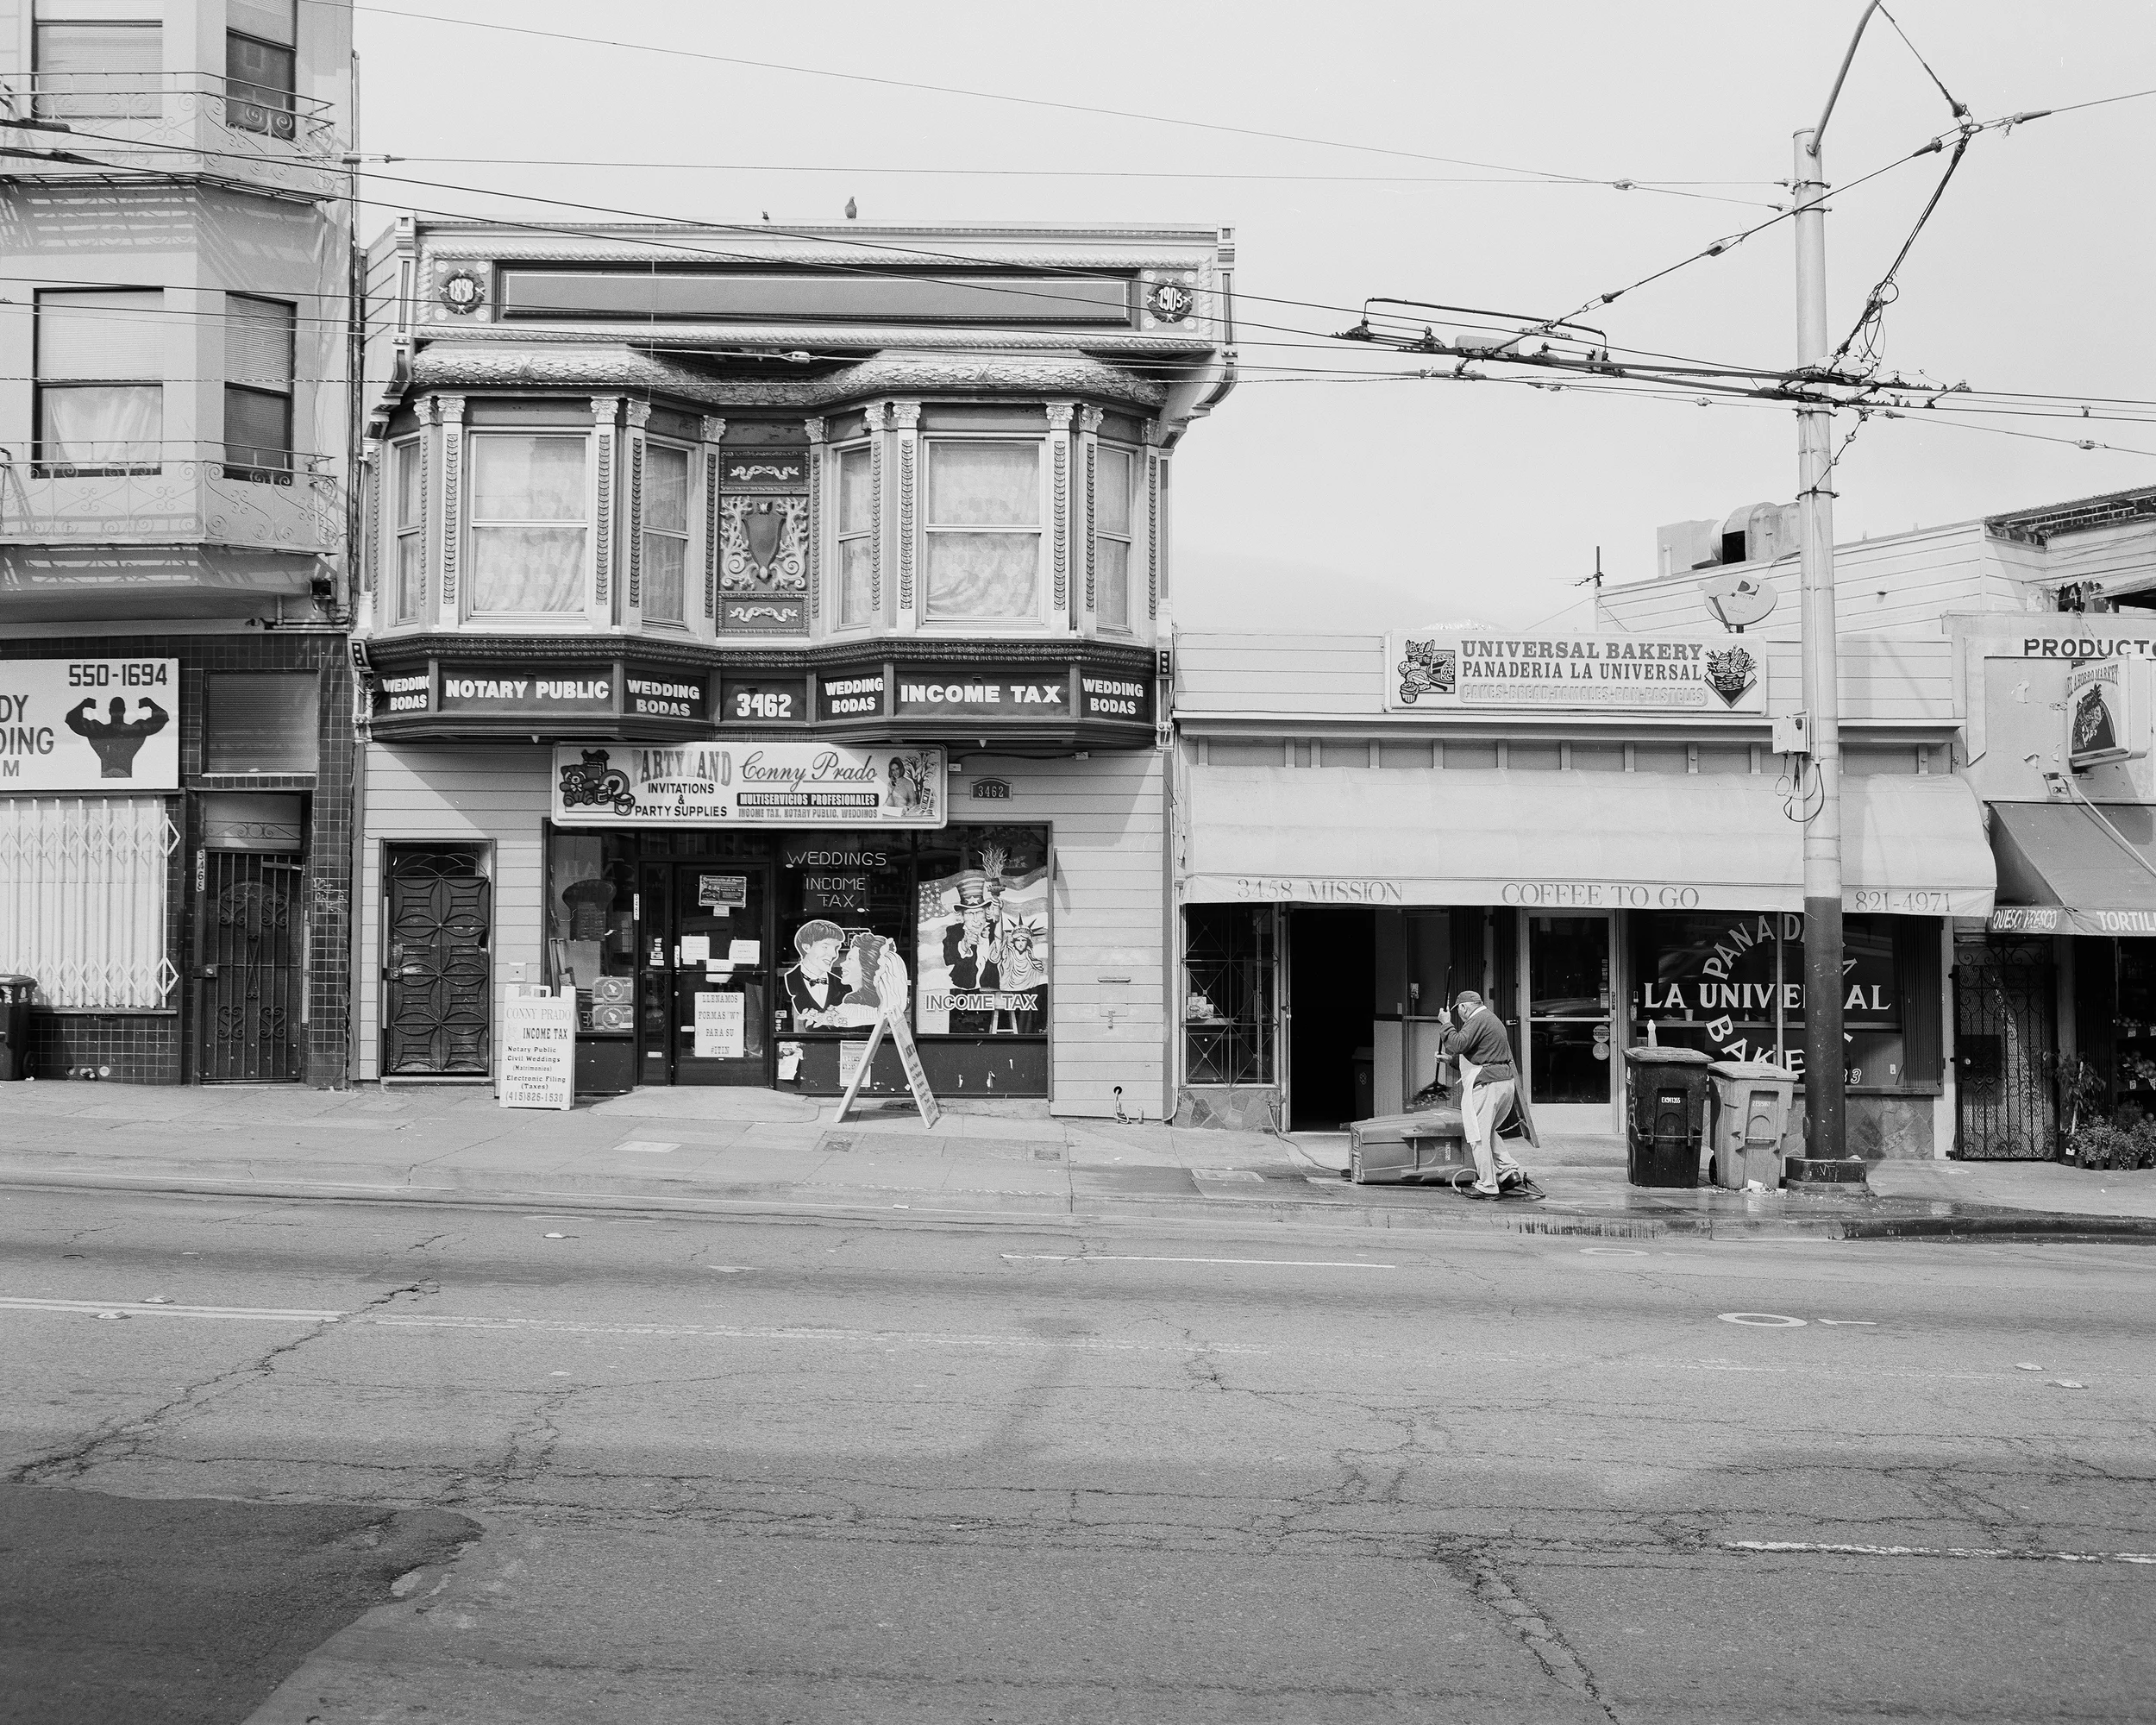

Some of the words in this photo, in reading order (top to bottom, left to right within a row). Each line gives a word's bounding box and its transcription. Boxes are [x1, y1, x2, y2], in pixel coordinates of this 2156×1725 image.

[1158, 286, 1183, 311] 1905
[1461, 641, 1600, 660] UNIVERSAL
[1606, 642, 1703, 661] BAKERY
[2024, 639, 2156, 657] PRODUCT
[69, 663, 167, 687] 550-1694
[1463, 662, 1564, 680] PANADERIA
[1570, 662, 1594, 680] LA
[1600, 662, 1702, 681] UNIVERSAL
[2095, 664, 2118, 686] MARKET
[446, 681, 529, 699] NOTARY
[536, 681, 609, 699] PUBLIC
[626, 680, 700, 700] WEDDING
[824, 677, 884, 696] WEDDING
[900, 685, 1000, 703] INCOME
[1010, 685, 1062, 703] TAX
[1082, 678, 1144, 698] WEDDING
[390, 694, 428, 712] BODAS
[636, 699, 691, 717] BODAS
[736, 693, 792, 718] 3462
[832, 697, 876, 713] BODAS
[1090, 698, 1136, 715] BODAS
[739, 750, 807, 793] Conny
[812, 751, 878, 781] Prado
[648, 783, 715, 794] INVITATIONS
[978, 785, 1004, 798] 3462
[677, 794, 685, 805] &
[739, 794, 808, 806] MULTISERVICIOS
[811, 794, 875, 806] PROFESIONALES
[635, 806, 672, 817] PARTY
[674, 806, 728, 817] SUPPLIES
[738, 808, 764, 818] INCOME
[784, 808, 811, 819] NOTARY
[841, 808, 878, 819] WEDDINGS
[787, 851, 887, 866] WEDDINGS
[805, 877, 866, 891] INCOME
[1237, 878, 1293, 900] 3458
[1307, 880, 1403, 902] MISSION
[817, 894, 855, 908] TAX
[1501, 882, 1602, 906] COFFEE
[1611, 886, 1650, 907] TO
[1658, 887, 1700, 908] GO
[1855, 891, 1952, 913] 821-4971
[1993, 909, 2021, 930] QUESO
[702, 994, 738, 1003] LLENAMOS
[925, 994, 994, 1011] INCOME
[1001, 994, 1038, 1011] TAX
[1645, 983, 1687, 1008] LA
[1699, 983, 1891, 1010] UNIVEAL
[506, 1007, 536, 1019] CONNY
[541, 1008, 571, 1020] PRADO
[698, 1011, 726, 1019] FORMAS
[523, 1027, 551, 1039] INCOME
[554, 1028, 568, 1040] TAX
[705, 1028, 724, 1037] PARA
[726, 1028, 734, 1037] SU
[1706, 1014, 1853, 1075] BAKE
